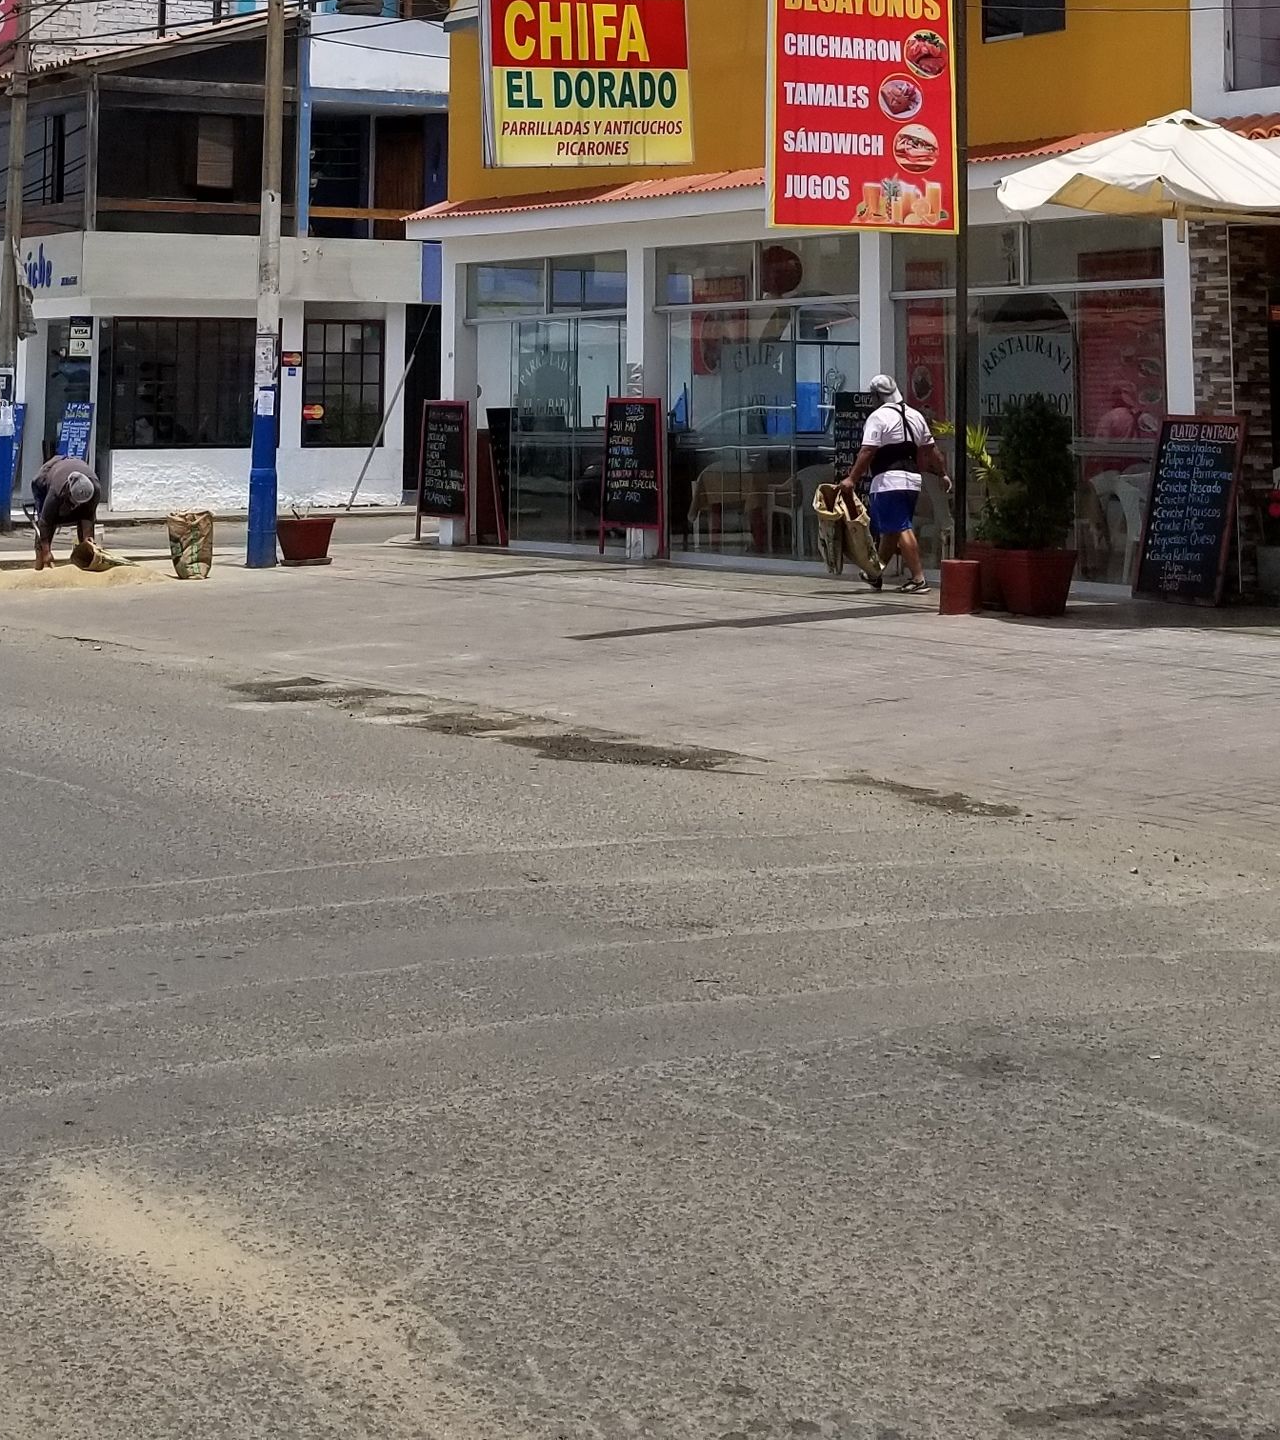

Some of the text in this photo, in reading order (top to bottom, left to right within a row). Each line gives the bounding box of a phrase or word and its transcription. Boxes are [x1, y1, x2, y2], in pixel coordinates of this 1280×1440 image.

[504, 0, 650, 62] CHIFA
[784, 33, 902, 62] CHICHARRON
[506, 71, 677, 108] EL DORADO
[783, 82, 869, 108] TAMALES
[501, 120, 683, 136] PARRILLADAS Y ANTICUCHOS
[783, 127, 884, 156] SÁNDWICH
[557, 141, 629, 156] PICARONES
[784, 173, 851, 200] JUGOS
[1170, 424, 1239, 440] PLATOS ENTRADA
